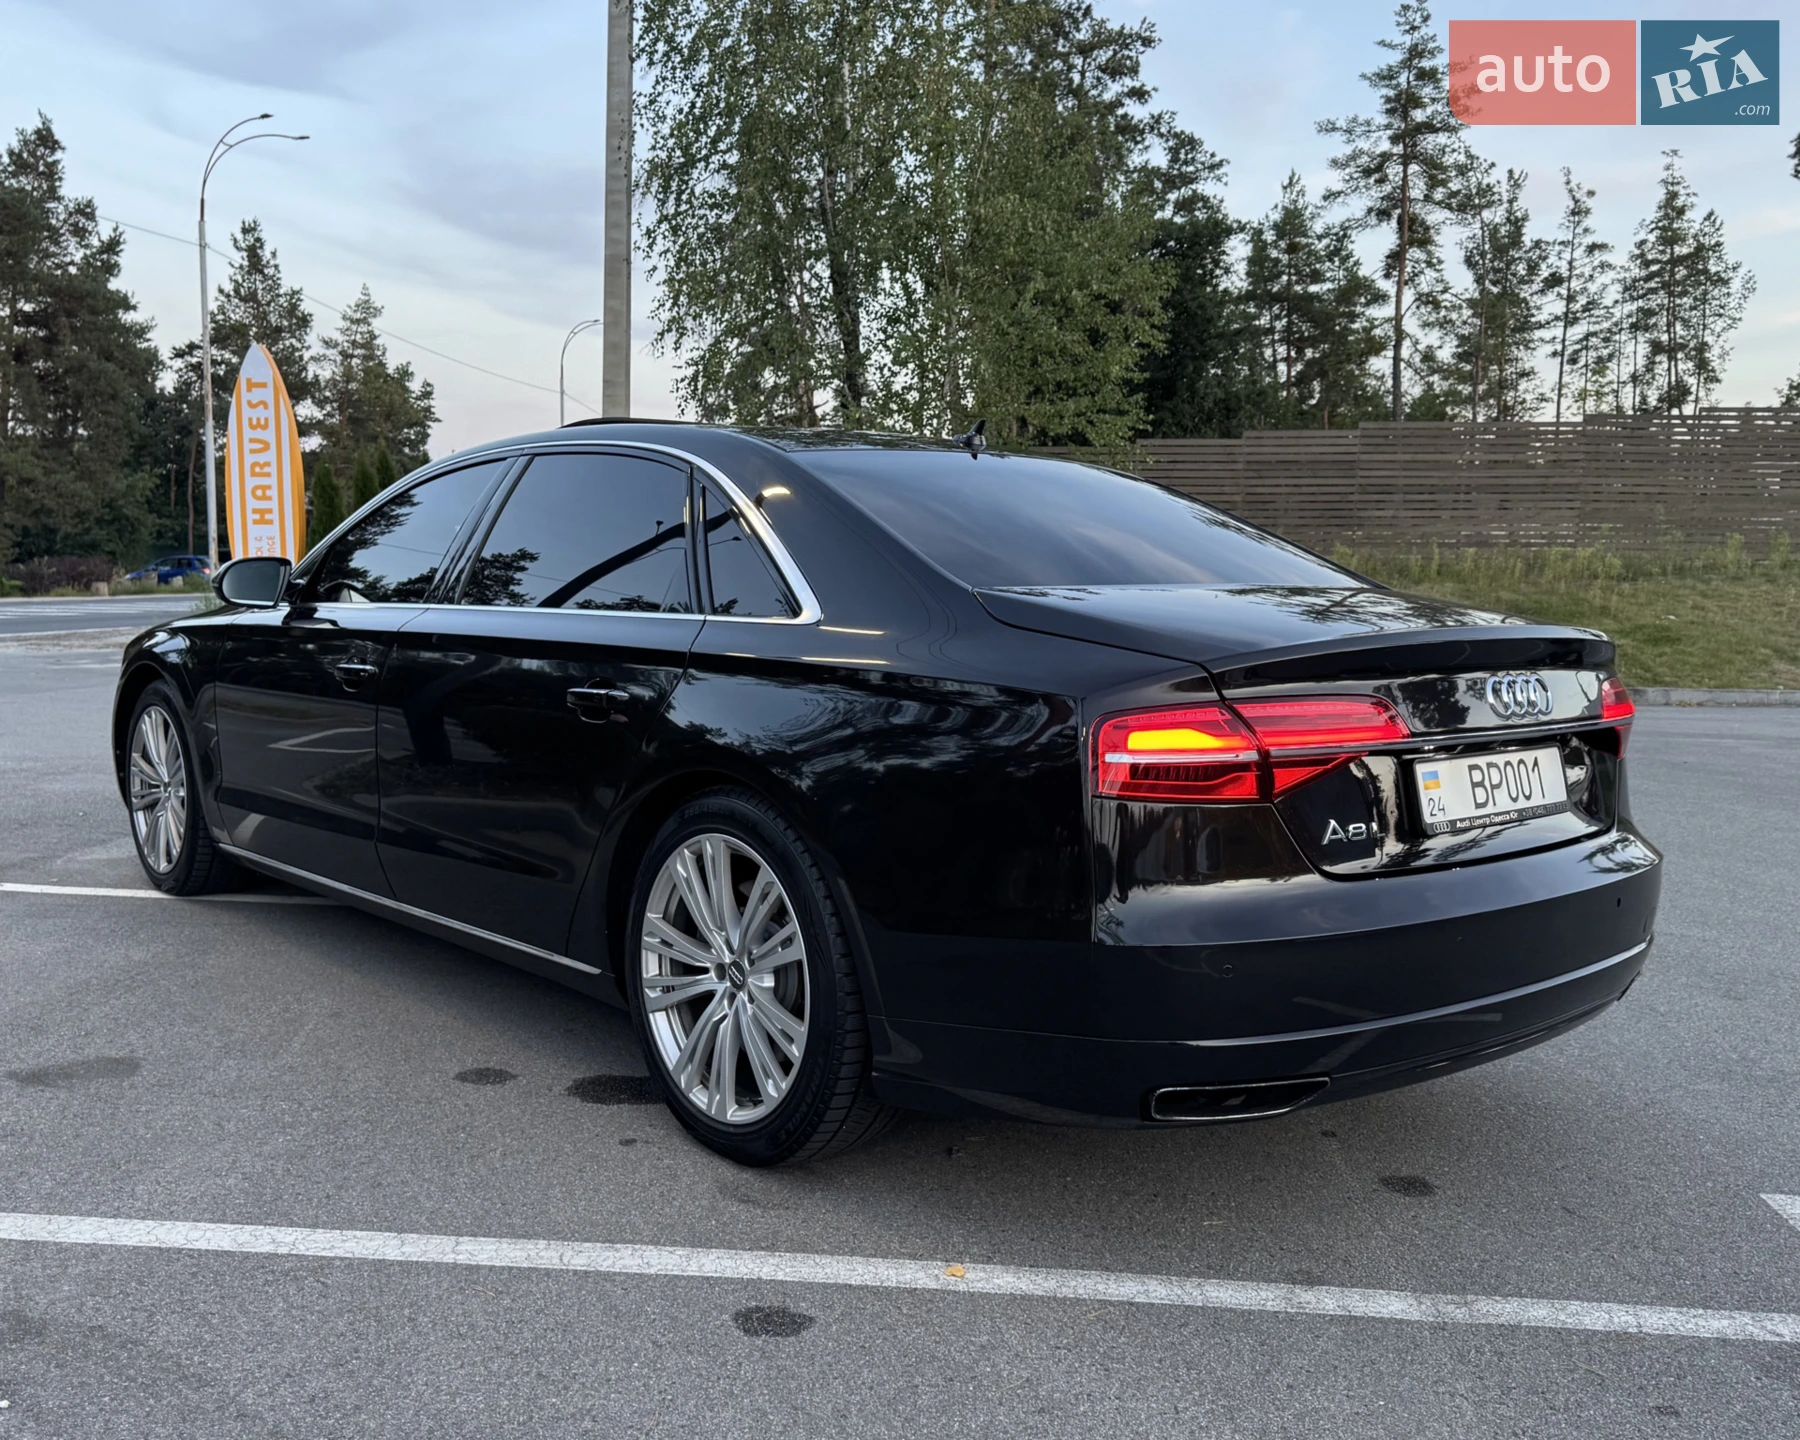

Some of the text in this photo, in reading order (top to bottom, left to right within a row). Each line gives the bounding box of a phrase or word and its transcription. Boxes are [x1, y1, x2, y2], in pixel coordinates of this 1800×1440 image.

[246, 377, 274, 525] HARVEST
[1467, 756, 1545, 810] BP001
[1428, 796, 1446, 817] 24
[1456, 819, 1470, 829] Audi
[1471, 816, 1490, 826] Центр
[1490, 814, 1510, 824] Одесса
